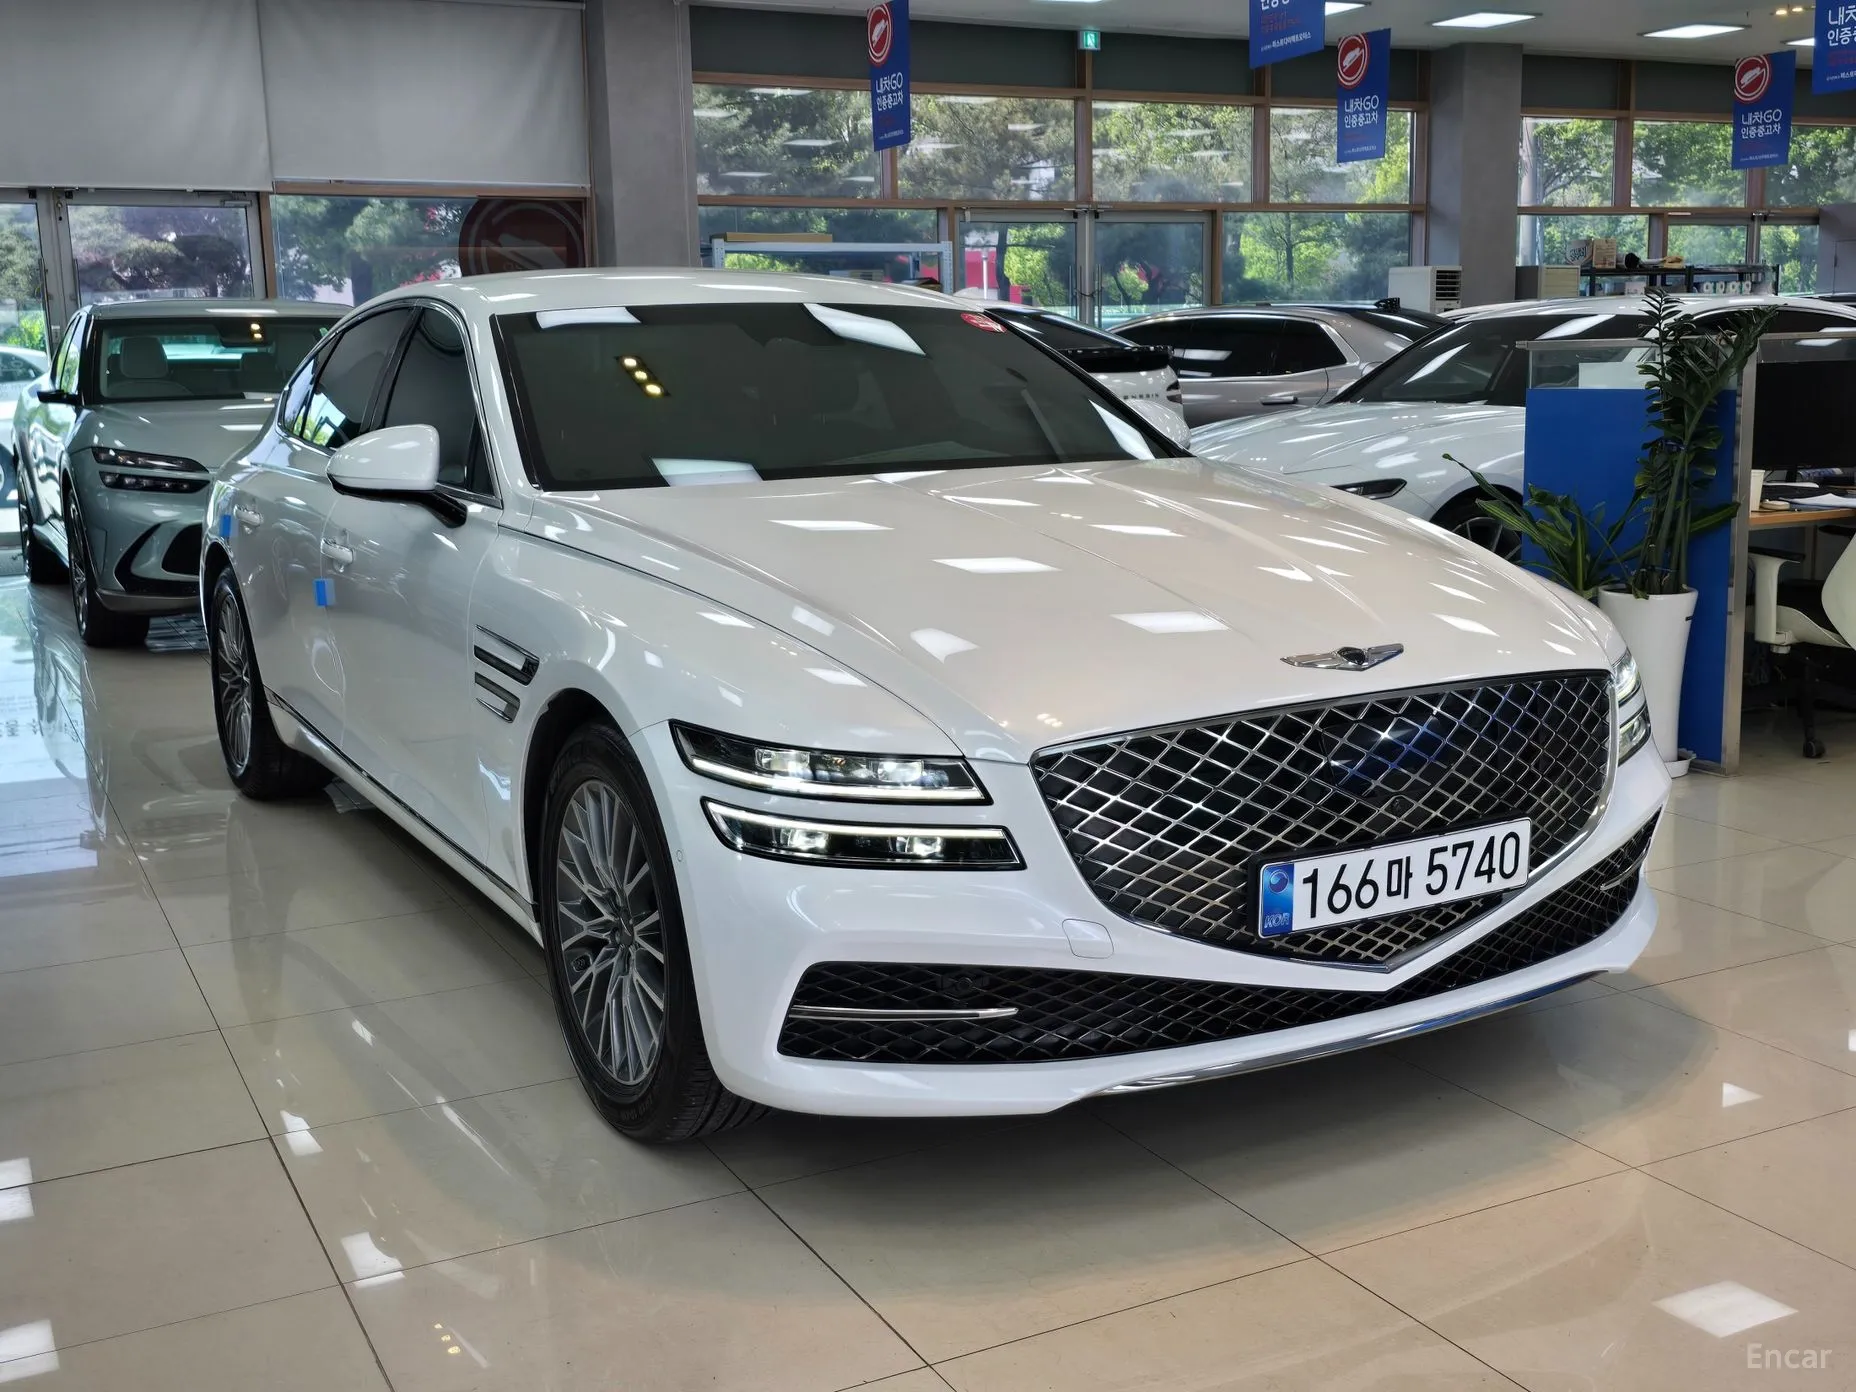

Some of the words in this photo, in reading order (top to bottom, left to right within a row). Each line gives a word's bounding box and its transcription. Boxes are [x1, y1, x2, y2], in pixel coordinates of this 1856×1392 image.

[875, 72, 903, 93] 내차GO
[1344, 94, 1380, 113] 내차GO
[1344, 110, 1379, 128] 인증중고차
[1741, 108, 1783, 126] 내차GO
[1741, 123, 1781, 139] 인증중고차
[1302, 855, 1413, 919] 166마
[1425, 830, 1521, 897] 5740
[1264, 911, 1290, 929] KOR
